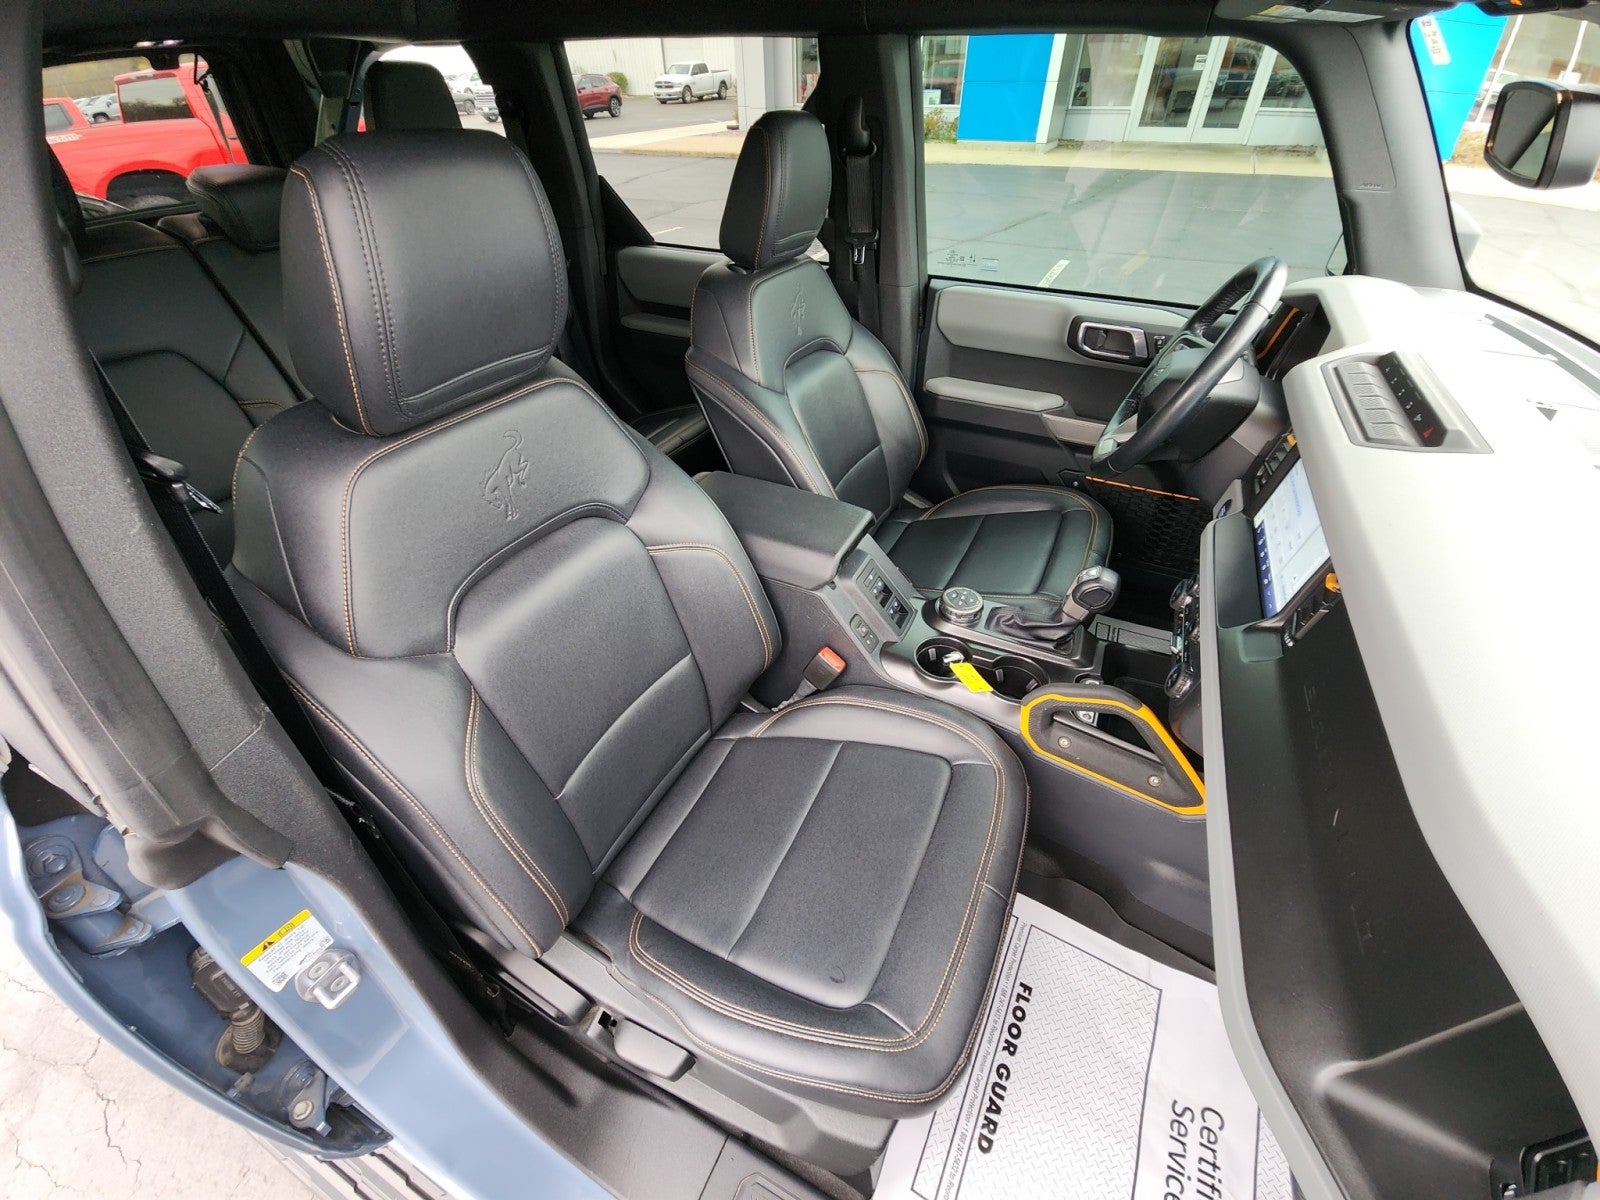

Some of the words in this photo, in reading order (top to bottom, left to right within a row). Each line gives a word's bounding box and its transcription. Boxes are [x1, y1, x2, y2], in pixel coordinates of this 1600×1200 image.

[1002, 982, 1033, 1057] FLOOR
[978, 1048, 990, 1073] Premium
[971, 1072, 983, 1093] Carpet
[964, 1092, 978, 1122] Protection
[978, 1063, 1011, 1154] GUARD
